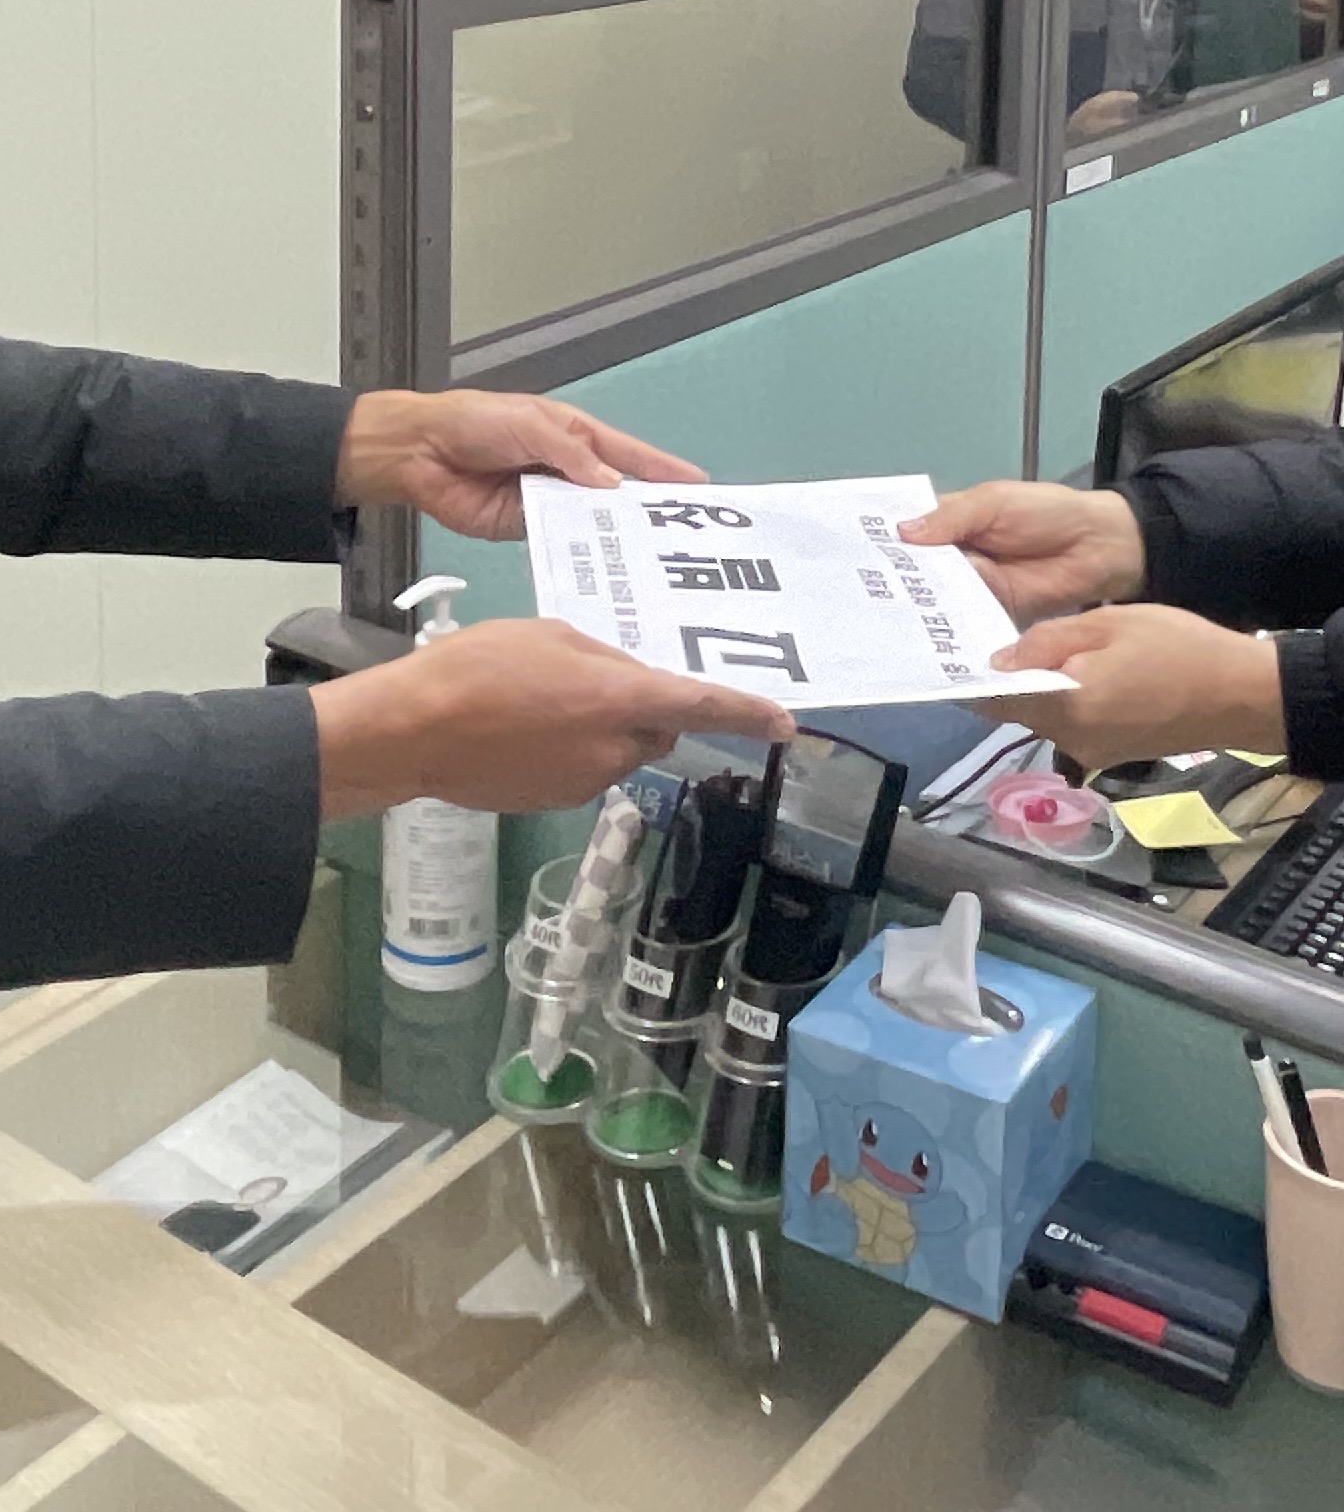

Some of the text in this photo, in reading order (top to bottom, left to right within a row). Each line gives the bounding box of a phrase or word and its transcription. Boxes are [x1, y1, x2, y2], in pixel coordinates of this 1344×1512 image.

[641, 498, 810, 684] 고 발 장
